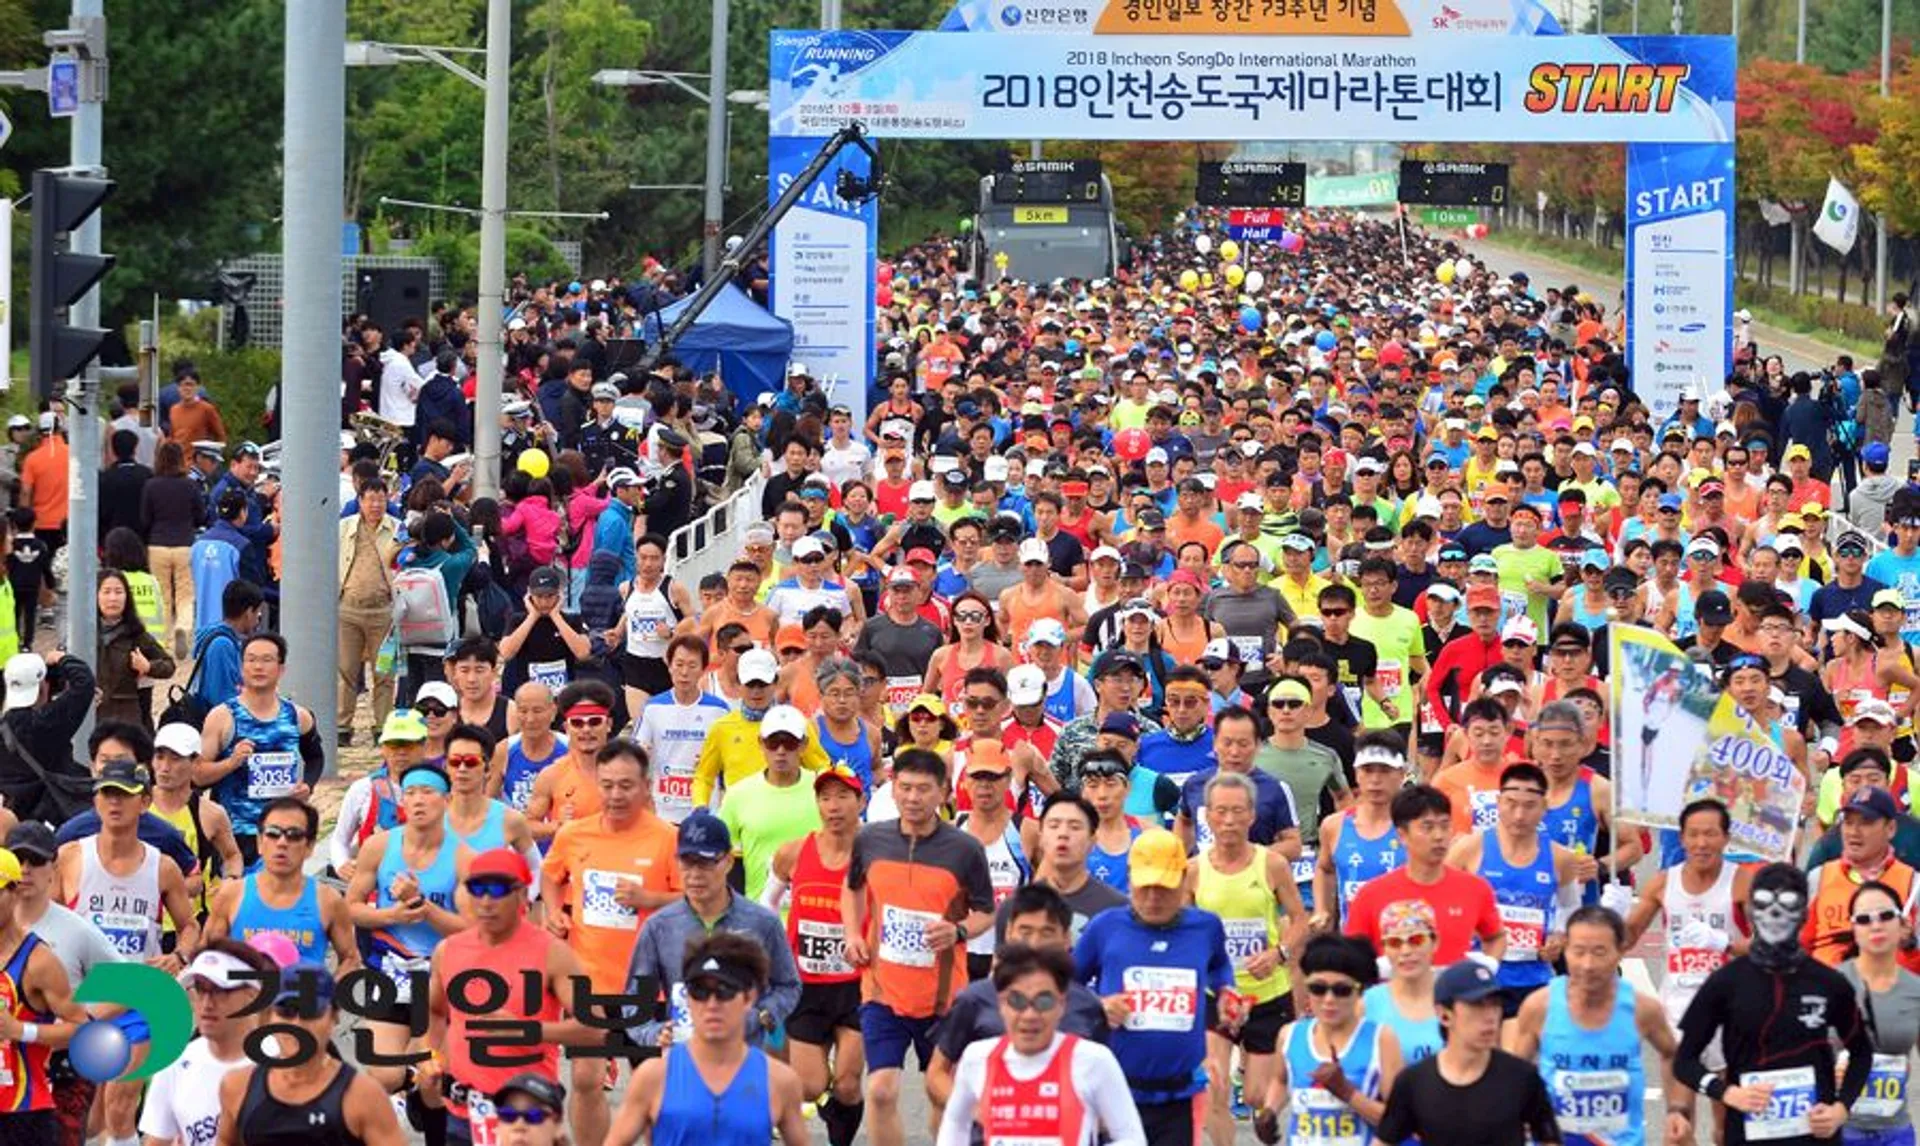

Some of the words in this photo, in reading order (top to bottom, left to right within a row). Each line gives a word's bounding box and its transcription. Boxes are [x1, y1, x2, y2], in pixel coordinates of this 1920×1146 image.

[1025, 8, 1088, 24] 신한은행
[1338, 0, 1376, 23] 기념
[1432, 17, 1449, 29] SK
[775, 35, 822, 48] SongDo
[804, 47, 876, 61] RUNNING
[1066, 51, 1107, 66] 2018
[1111, 51, 1172, 66] Incheon
[1177, 51, 1235, 69] SongDo
[1239, 51, 1338, 67] International
[1342, 52, 1416, 68] Marathon
[983, 69, 1501, 121] 2018인천송도국제마라톤대회
[1524, 62, 1690, 114] START
[1025, 161, 1075, 172] SAMIK
[1085, 181, 1099, 200] 0
[1635, 176, 1726, 217] START
[1026, 210, 1055, 222] 5km
[1243, 212, 1271, 224] Full
[1430, 212, 1468, 223] 10km
[1241, 228, 1272, 240] Half
[252, 769, 292, 786] 3035
[1131, 991, 1190, 1013] 1278
[1560, 1094, 1624, 1118] 3190
[1296, 1112, 1356, 1138] 5115
